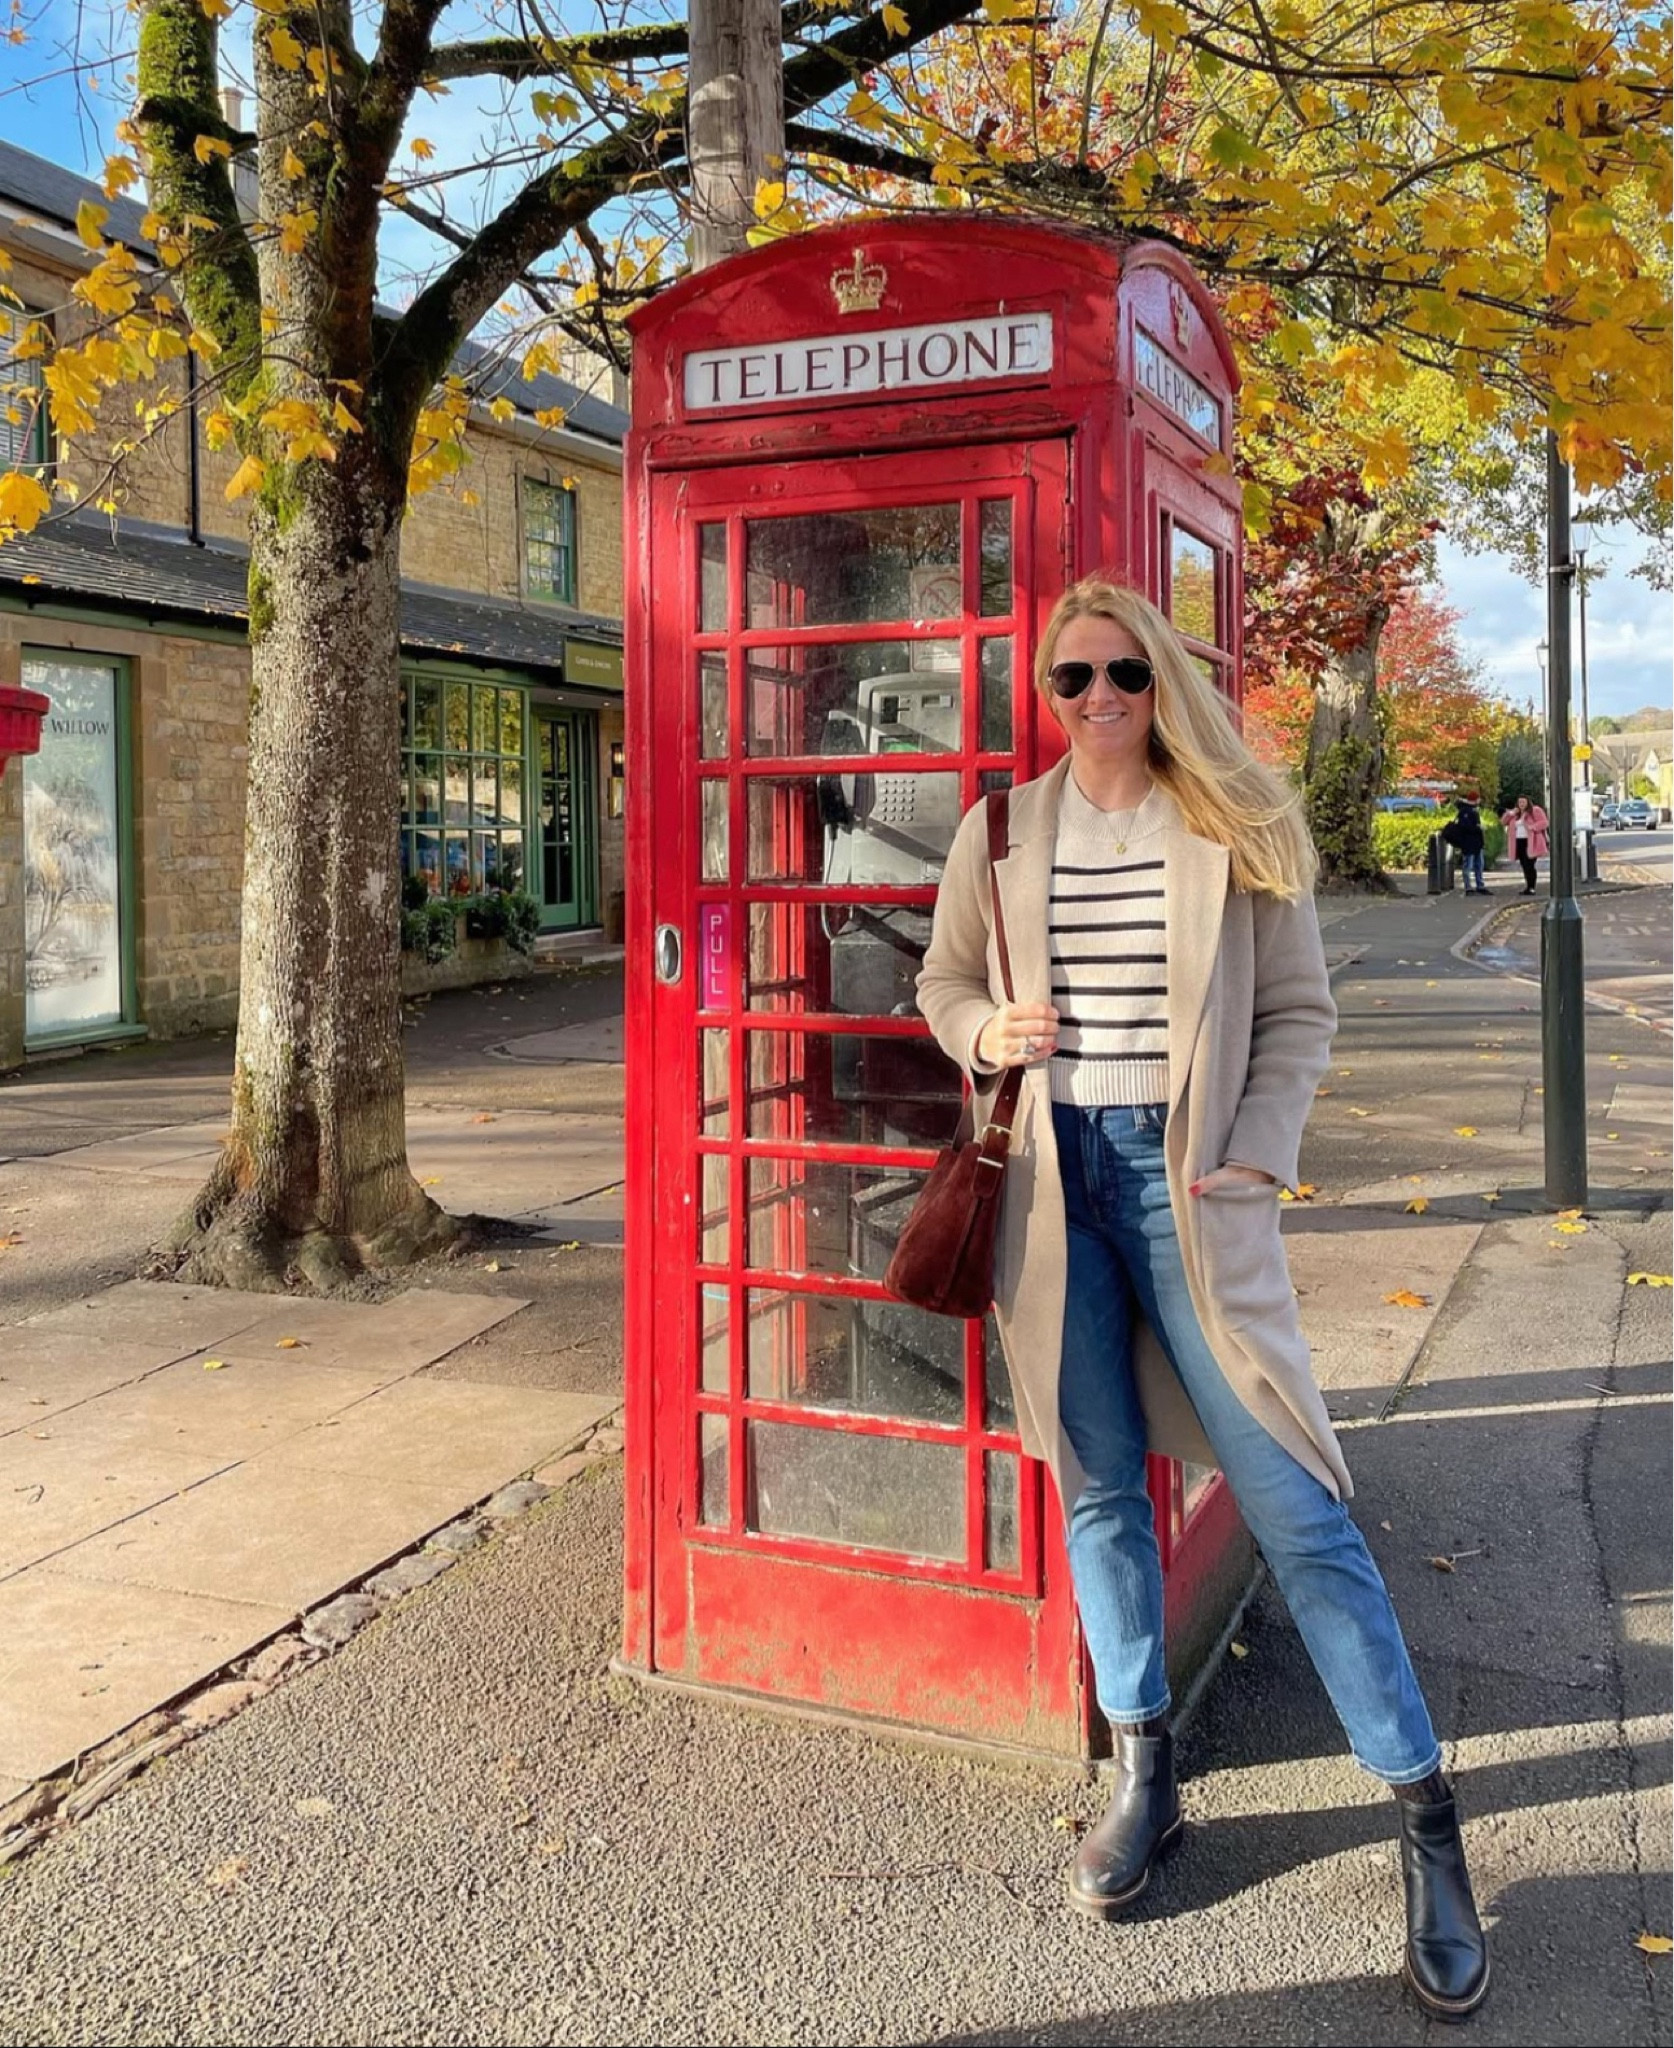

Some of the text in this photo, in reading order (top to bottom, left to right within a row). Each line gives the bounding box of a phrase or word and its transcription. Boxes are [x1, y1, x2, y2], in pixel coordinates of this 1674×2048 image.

[700, 323, 1040, 402] TELEPHONE
[51, 718, 110, 735] WILLOW
[710, 914, 724, 994] PULL
